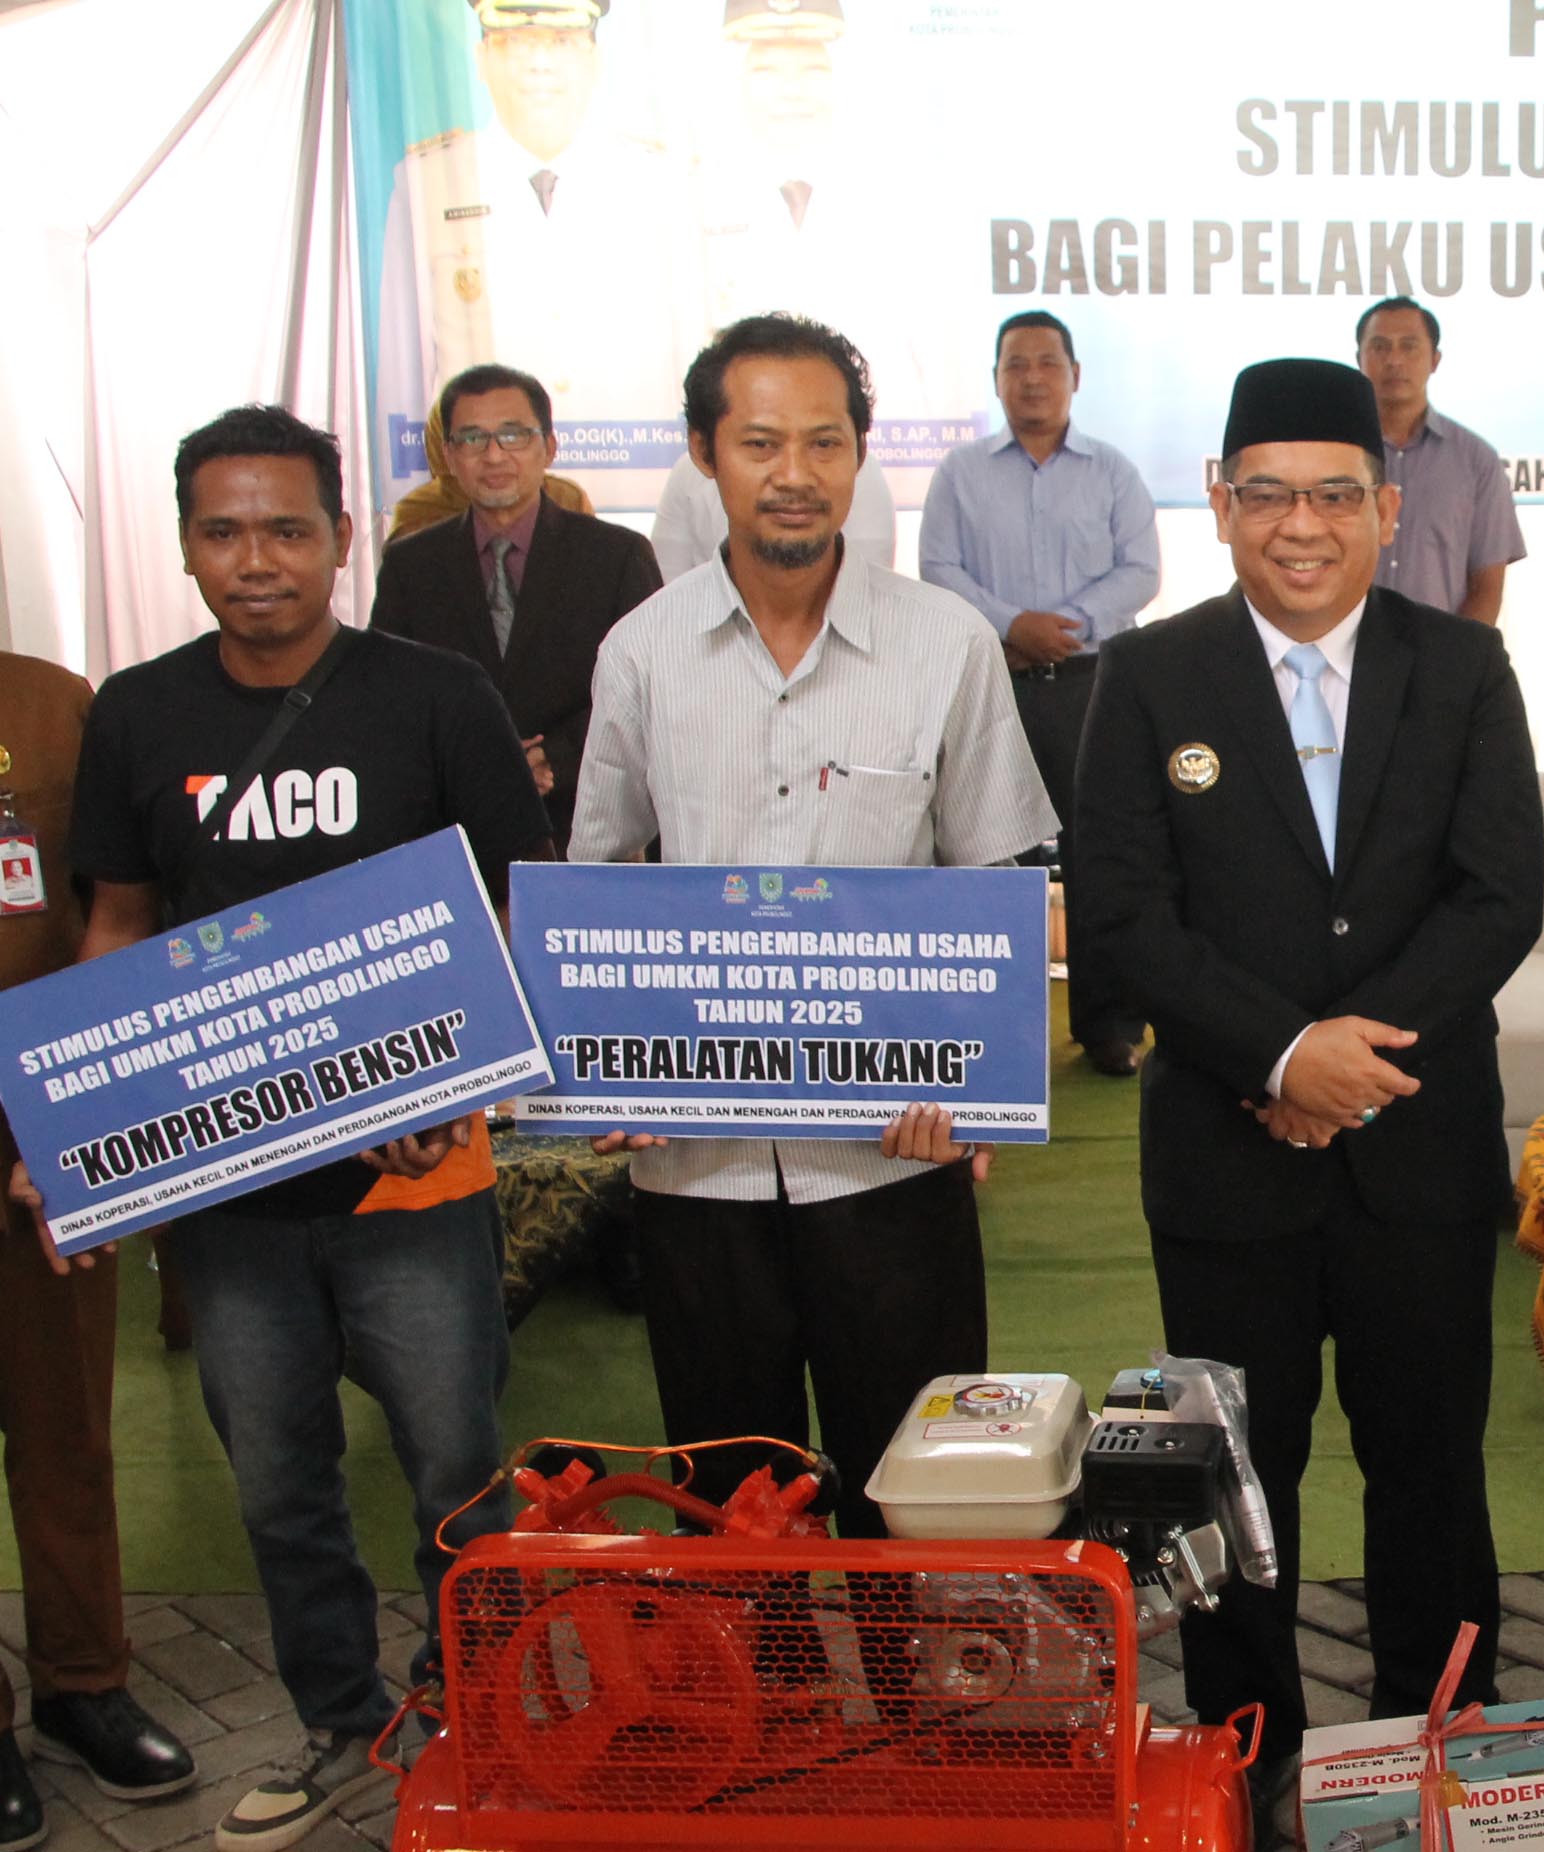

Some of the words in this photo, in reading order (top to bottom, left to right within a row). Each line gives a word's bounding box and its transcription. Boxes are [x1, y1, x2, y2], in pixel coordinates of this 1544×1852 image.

[990, 218, 1166, 296] BAGI
[1193, 220, 1464, 298] PELAKU
[185, 766, 359, 841] TACO
[543, 926, 685, 956] STIMULUS
[688, 928, 913, 959] PENGEMBANGAN
[916, 931, 1014, 961] USAHA
[18, 1009, 153, 1077] STIMULUS
[151, 931, 364, 1029] PENGEMBANGAN
[361, 899, 455, 952] USAHA
[559, 962, 628, 989] BAGI
[631, 962, 721, 990] UMKM
[725, 963, 798, 991] KOTA
[801, 964, 998, 994] PROBOLINGGO
[43, 1059, 112, 1104] BAGI
[109, 1028, 198, 1079] UMKM
[196, 1003, 270, 1049] KOTA
[265, 937, 451, 1024] PROBOLINGGO
[692, 997, 785, 1025] TAHUN
[789, 998, 864, 1026] 2025
[177, 1039, 269, 1091] TAHUN
[266, 1014, 340, 1061] 2025
[555, 1037, 792, 1083] “PERALATAN
[801, 1040, 981, 1085] TUKANG”
[61, 1071, 315, 1187] “KOMPRESOR
[312, 1011, 464, 1103] BENSIN”
[527, 1103, 563, 1115] DINAS
[565, 1103, 626, 1117] KOPERASI,
[628, 1104, 668, 1116] USAHA
[670, 1105, 704, 1117] KECIL
[705, 1105, 731, 1117] DAN
[732, 1106, 798, 1118] MENENGAH
[800, 1107, 825, 1118] DAN
[827, 1107, 909, 1120] PERDAGANGA
[951, 1110, 1037, 1122] PROBOLINGGO
[59, 1215, 95, 1235] DINAS
[94, 1195, 154, 1223] KOPERASI,
[152, 1181, 193, 1202] USAHA
[191, 1170, 225, 1188] KECIL
[224, 1160, 250, 1177] DAN
[249, 1138, 312, 1168] MENENGAH
[311, 1129, 337, 1146] DAN
[336, 1099, 421, 1137] PERDAGANGAN
[420, 1088, 453, 1107] KOTA
[451, 1059, 532, 1096] PROBOLINGGO
[1469, 1815, 1503, 1828] Mod.
[1487, 1825, 1515, 1835] Mesin
